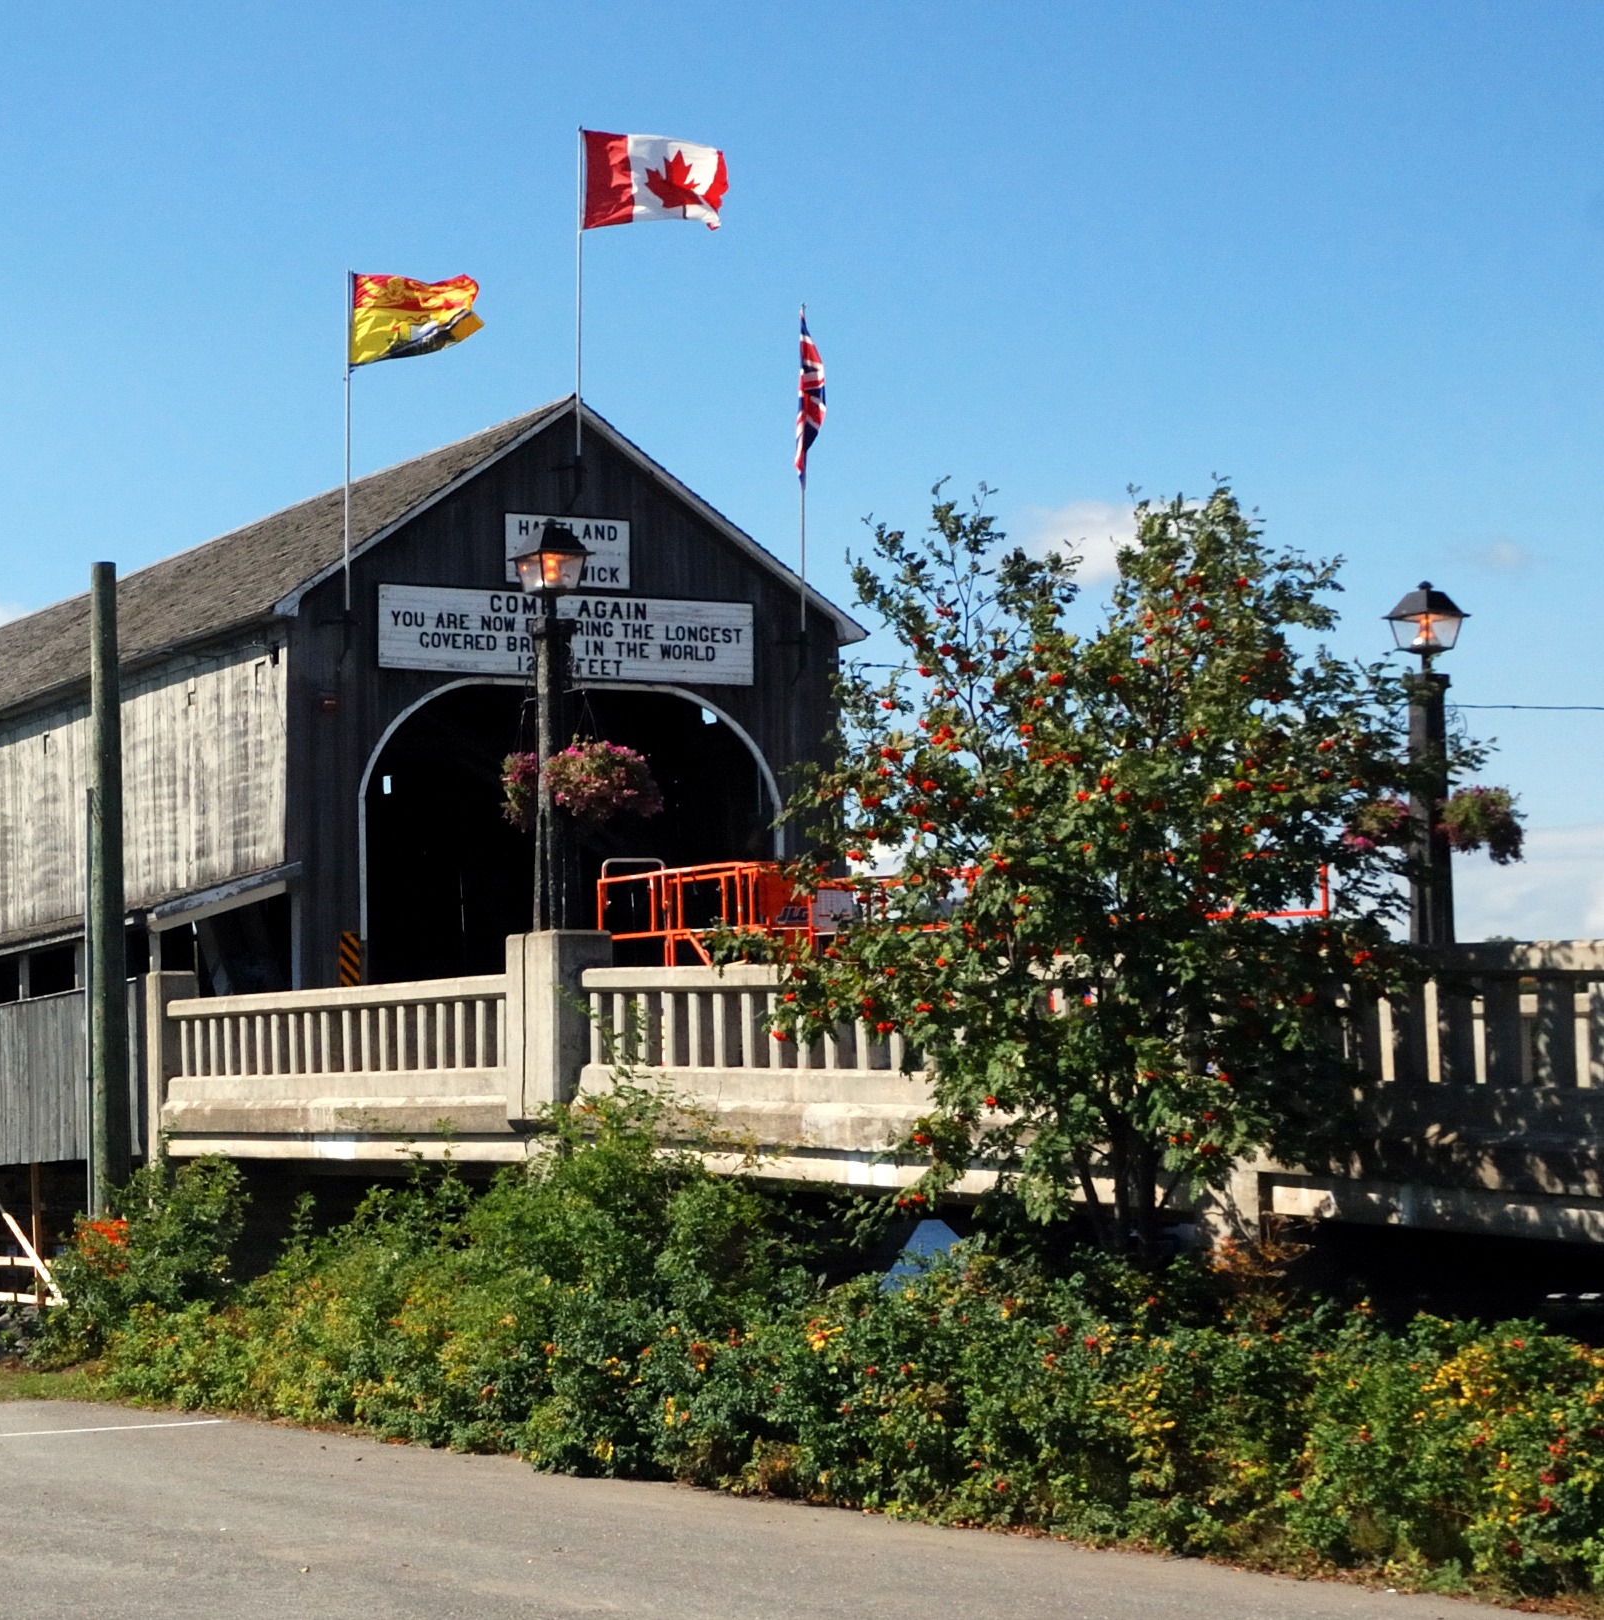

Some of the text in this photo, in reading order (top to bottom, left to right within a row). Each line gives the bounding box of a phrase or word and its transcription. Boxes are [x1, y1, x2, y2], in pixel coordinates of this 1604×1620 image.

[518, 519, 618, 541] HALAND
[577, 600, 647, 621] AGAIN
[391, 610, 743, 645] YOU ARE NOW ERING THE LONGEST
[419, 631, 498, 651] COVERED
[585, 640, 604, 656] IN
[615, 641, 650, 659] THE
[660, 643, 716, 662] WORLD
[576, 657, 624, 677] FEET
